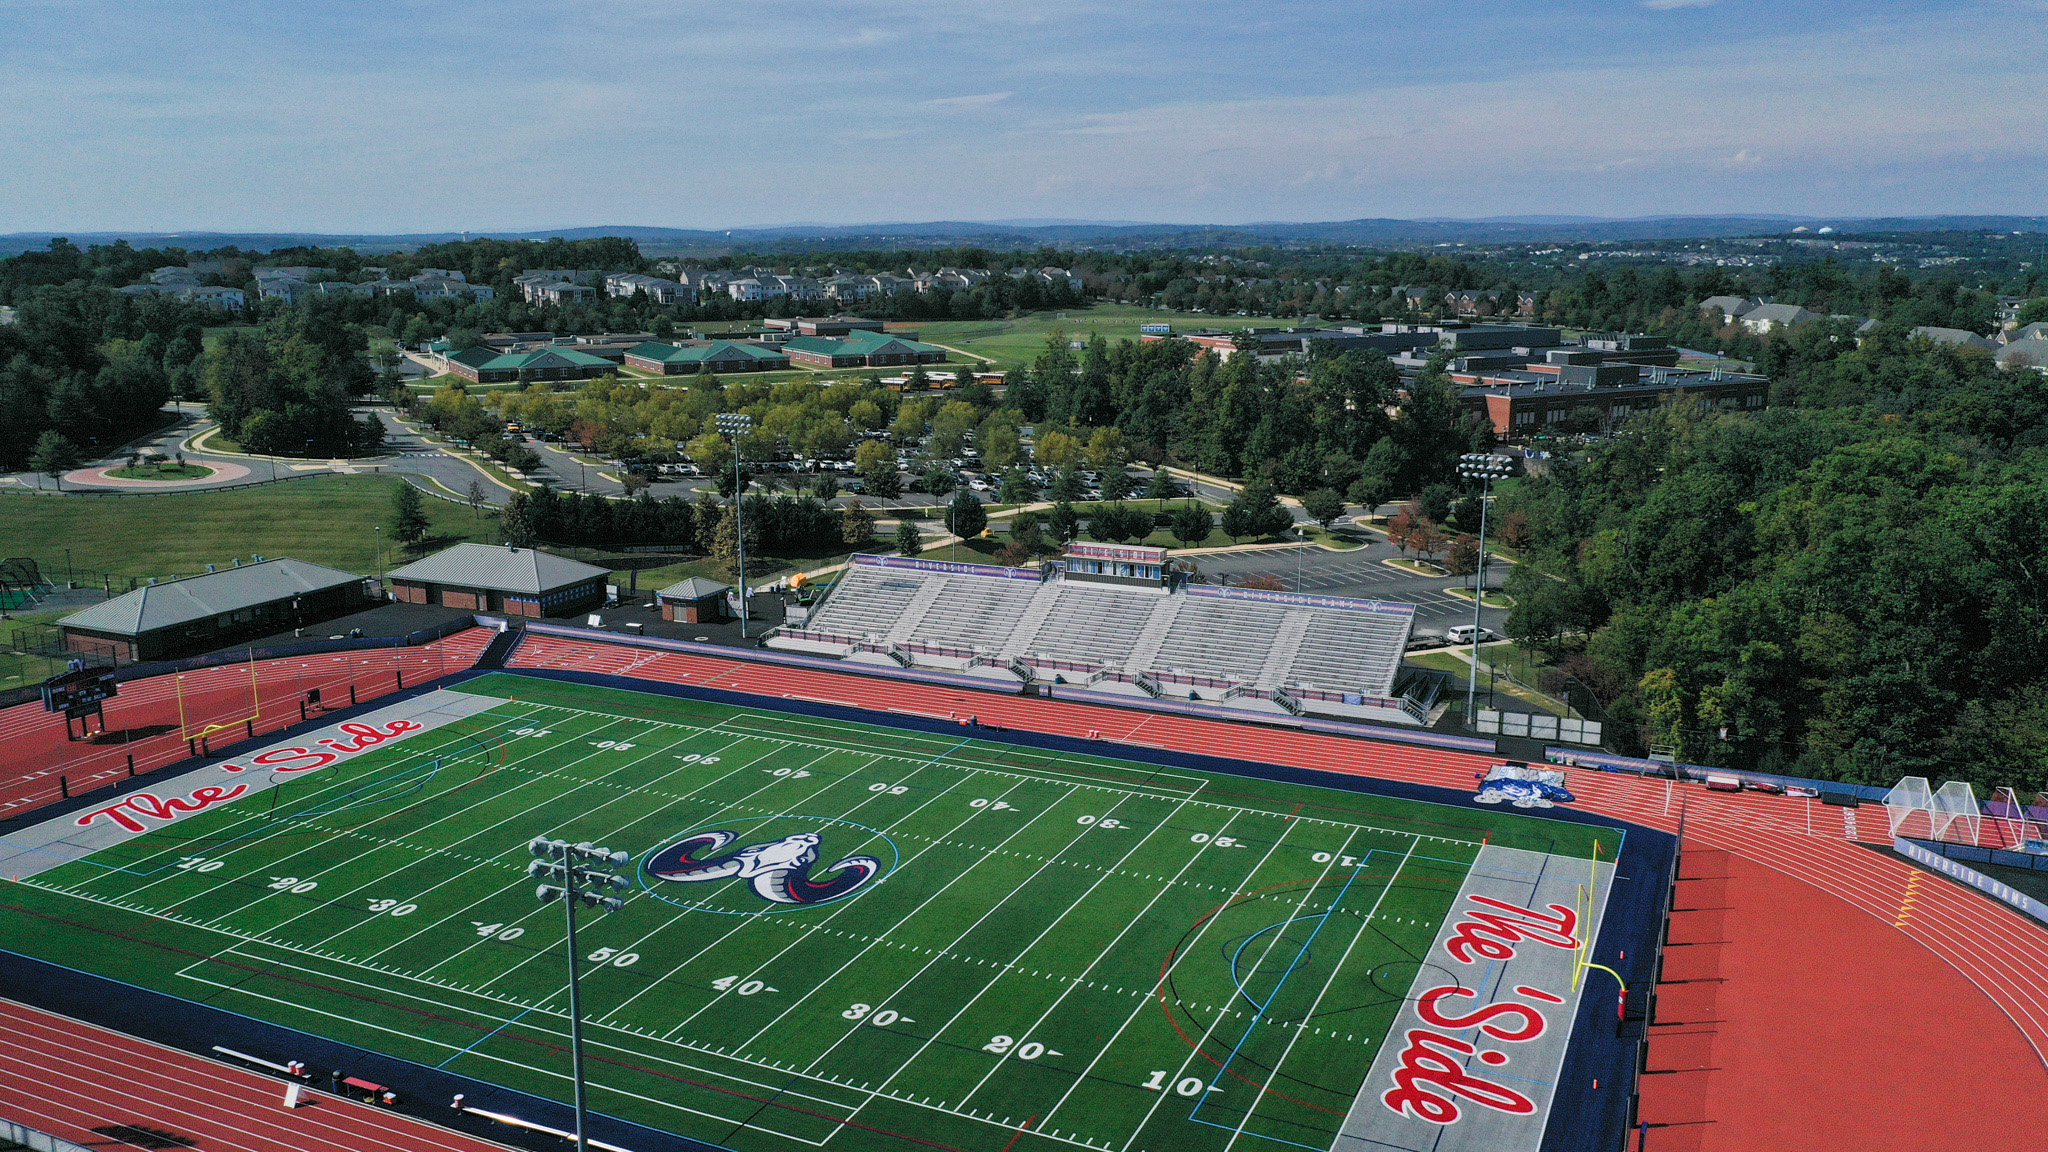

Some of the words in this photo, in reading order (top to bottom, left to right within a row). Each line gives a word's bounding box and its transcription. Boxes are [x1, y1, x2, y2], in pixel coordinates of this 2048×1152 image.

[1082, 547, 1144, 559] RIESIDE
[915, 560, 975, 574] RIVERSIDE
[1243, 591, 1311, 605] RIVERSIDE
[1321, 597, 1354, 609] RAMS
[74, 784, 249, 833] The
[174, 857, 225, 872] 10
[1311, 852, 1358, 867] 10
[268, 877, 319, 894] 20
[1908, 844, 1983, 887] RIVERSIDE
[1992, 882, 2029, 910] RAMS
[368, 899, 418, 917] 30
[476, 922, 525, 941] 40
[1443, 894, 1583, 964] The
[587, 947, 640, 967] 50
[711, 975, 764, 996] 40
[842, 1003, 899, 1026] 30
[981, 1035, 1045, 1060] 20
[1142, 1070, 1203, 1096] 10
